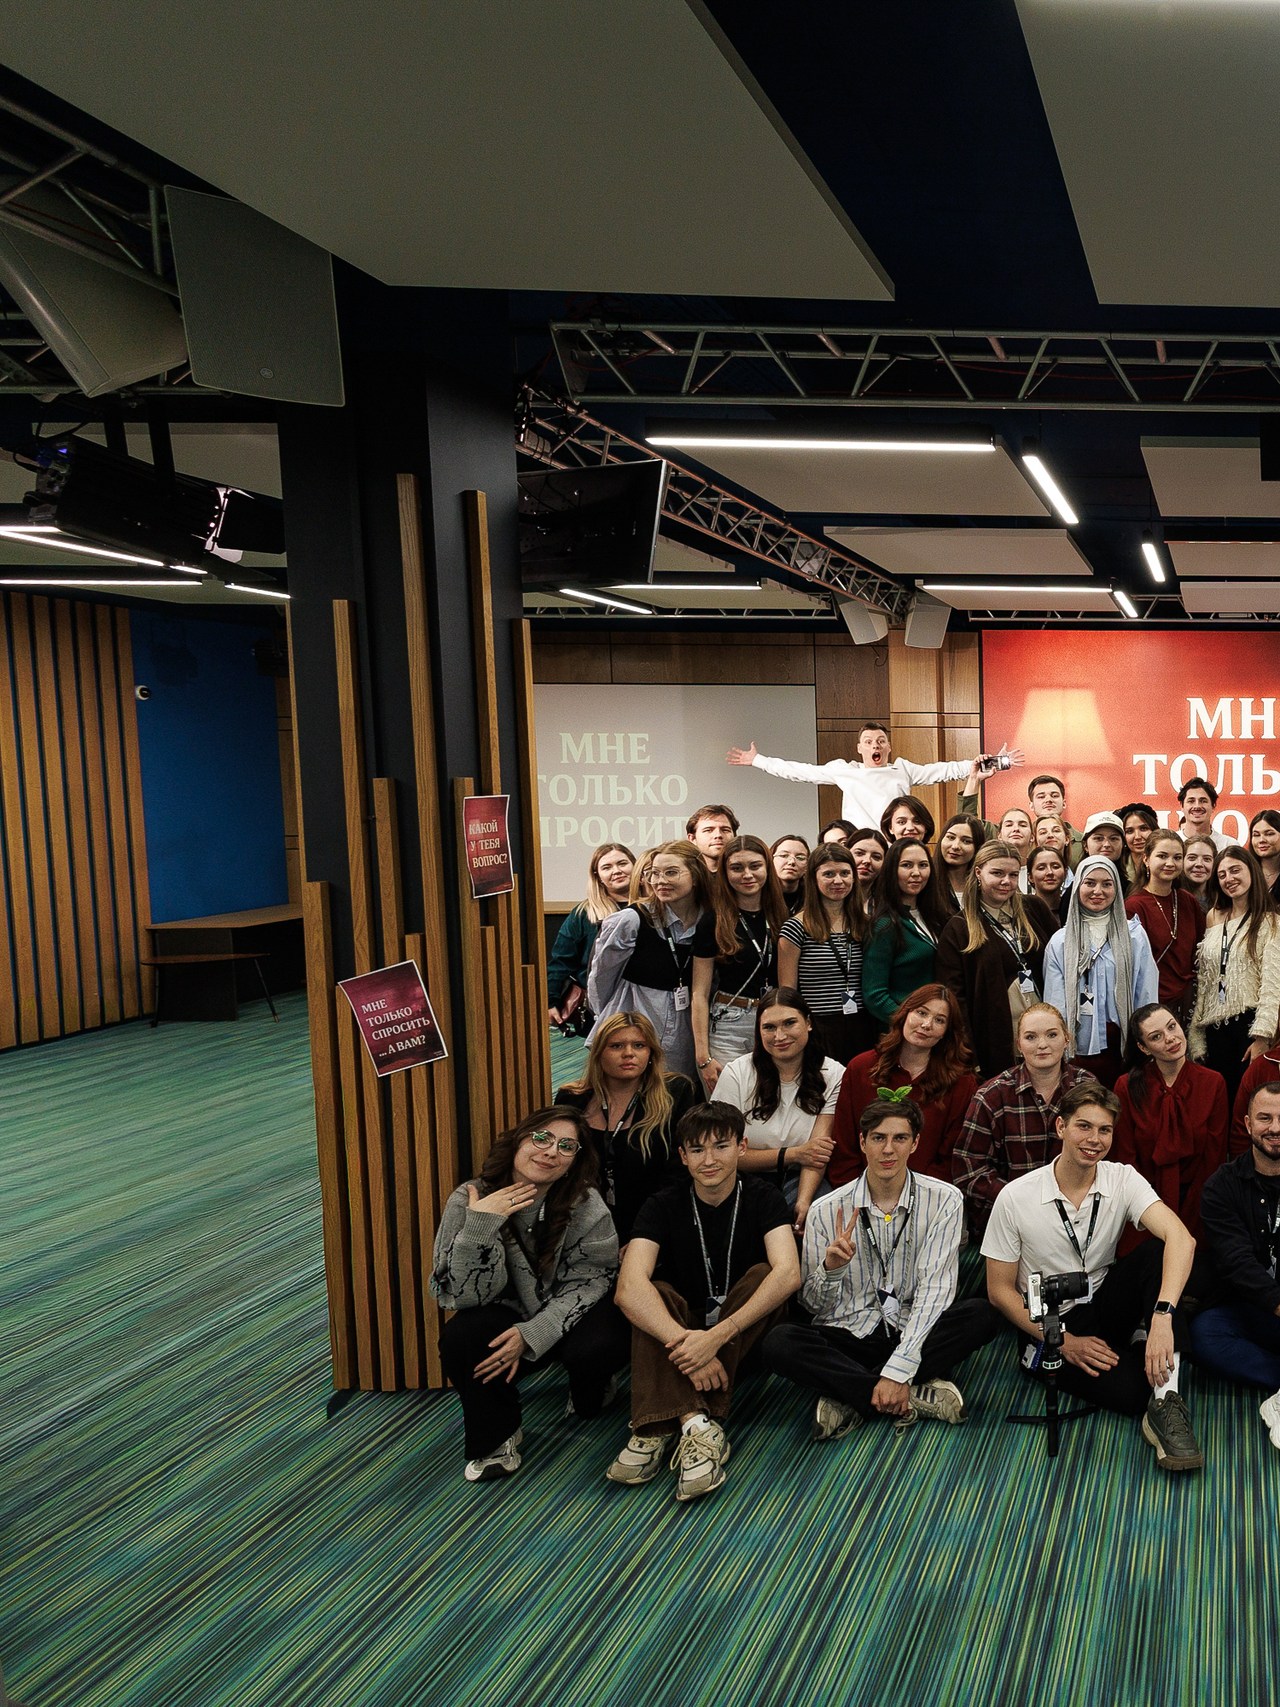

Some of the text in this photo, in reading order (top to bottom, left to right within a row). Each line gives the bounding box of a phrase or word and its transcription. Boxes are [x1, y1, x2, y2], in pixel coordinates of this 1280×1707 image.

[559, 732, 651, 764] МНЕ
[468, 819, 498, 835] КАКОЙ
[470, 838, 500, 851] У ТЕБЯ
[472, 853, 508, 868] ВОПРОС?
[361, 999, 388, 1014] МНЕ
[366, 1006, 413, 1027] ТОЛЬКО
[371, 1017, 431, 1040] СПРОСИТЬ
